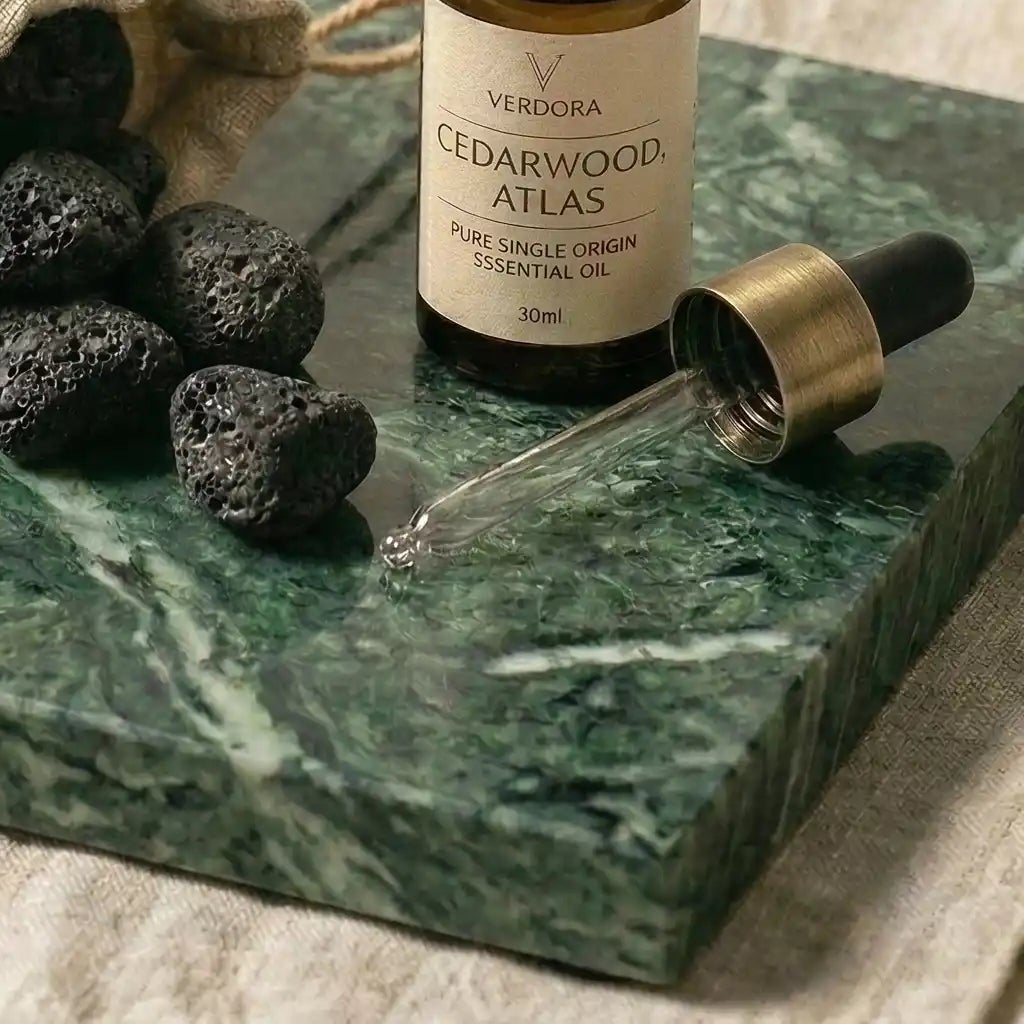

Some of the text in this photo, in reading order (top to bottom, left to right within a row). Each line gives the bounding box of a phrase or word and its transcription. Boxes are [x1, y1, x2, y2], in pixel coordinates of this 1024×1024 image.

[524, 51, 566, 92] V
[487, 90, 603, 117] VERDORA
[437, 122, 666, 179] CEDARWOOD,
[491, 183, 606, 216] ATLAS
[450, 220, 637, 259] PURE SINGLE ORIGIN
[579, 262, 611, 279] OIL
[518, 306, 562, 324] 30ml
